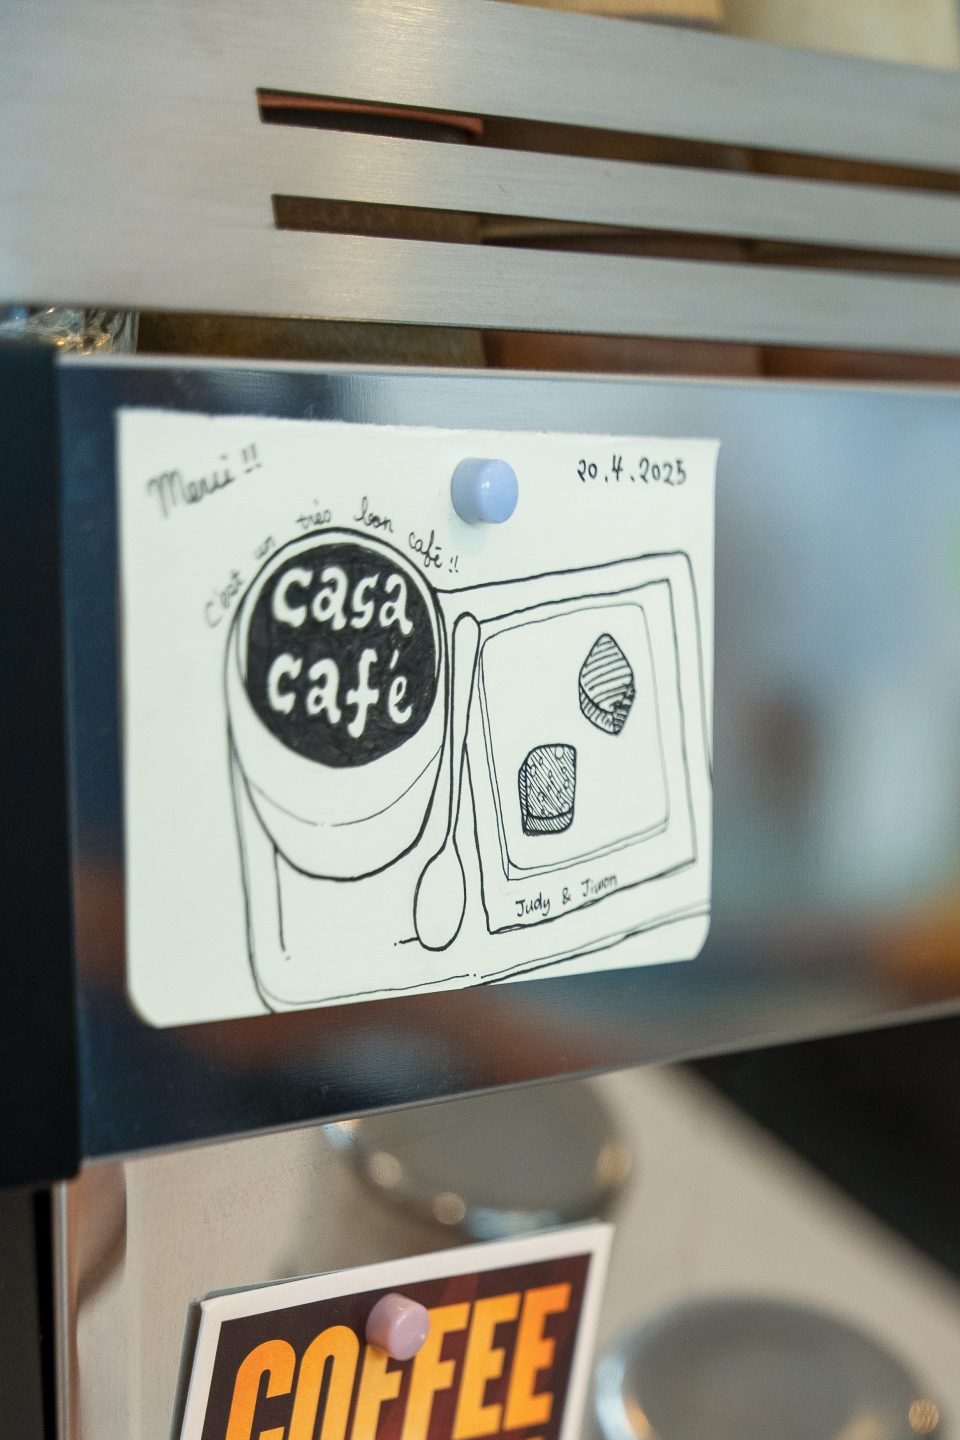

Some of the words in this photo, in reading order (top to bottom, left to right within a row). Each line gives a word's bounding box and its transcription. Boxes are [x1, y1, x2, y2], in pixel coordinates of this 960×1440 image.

[577, 453, 687, 486] 20.4.2025
[353, 495, 393, 533] bon
[272, 565, 414, 635] casa
[267, 647, 414, 739] café
[515, 891, 551, 917] Judy
[562, 887, 571, 905] &
